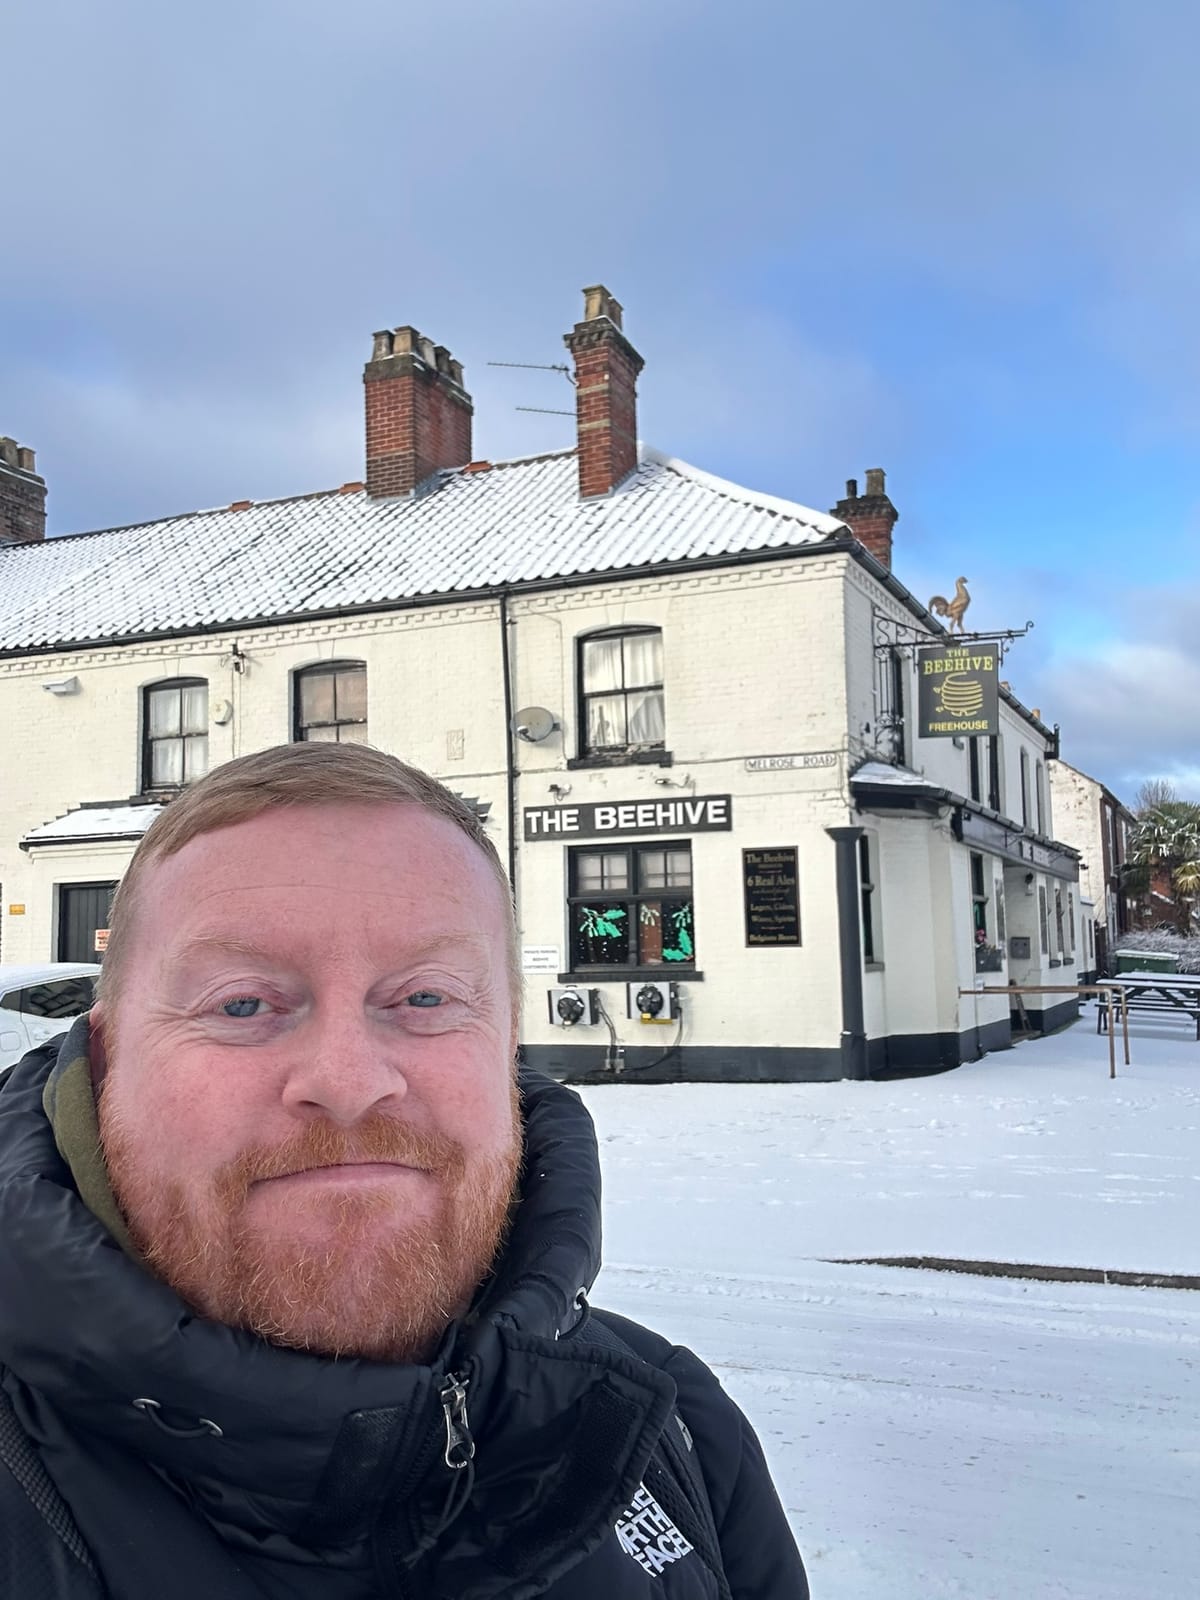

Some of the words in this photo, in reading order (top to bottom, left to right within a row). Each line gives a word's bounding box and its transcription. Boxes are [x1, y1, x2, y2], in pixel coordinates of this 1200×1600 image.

[946, 648, 969, 658] THE
[923, 656, 993, 675] BEEHIVE
[929, 720, 988, 732] FREEHOUSE
[748, 758, 794, 769] MELROSE
[803, 755, 833, 767] ROAD
[526, 809, 579, 833] THE
[595, 800, 727, 829] BEEHIVE
[755, 875, 774, 886] Real
[776, 874, 795, 885] Ales
[633, 1527, 691, 1577] FACE
